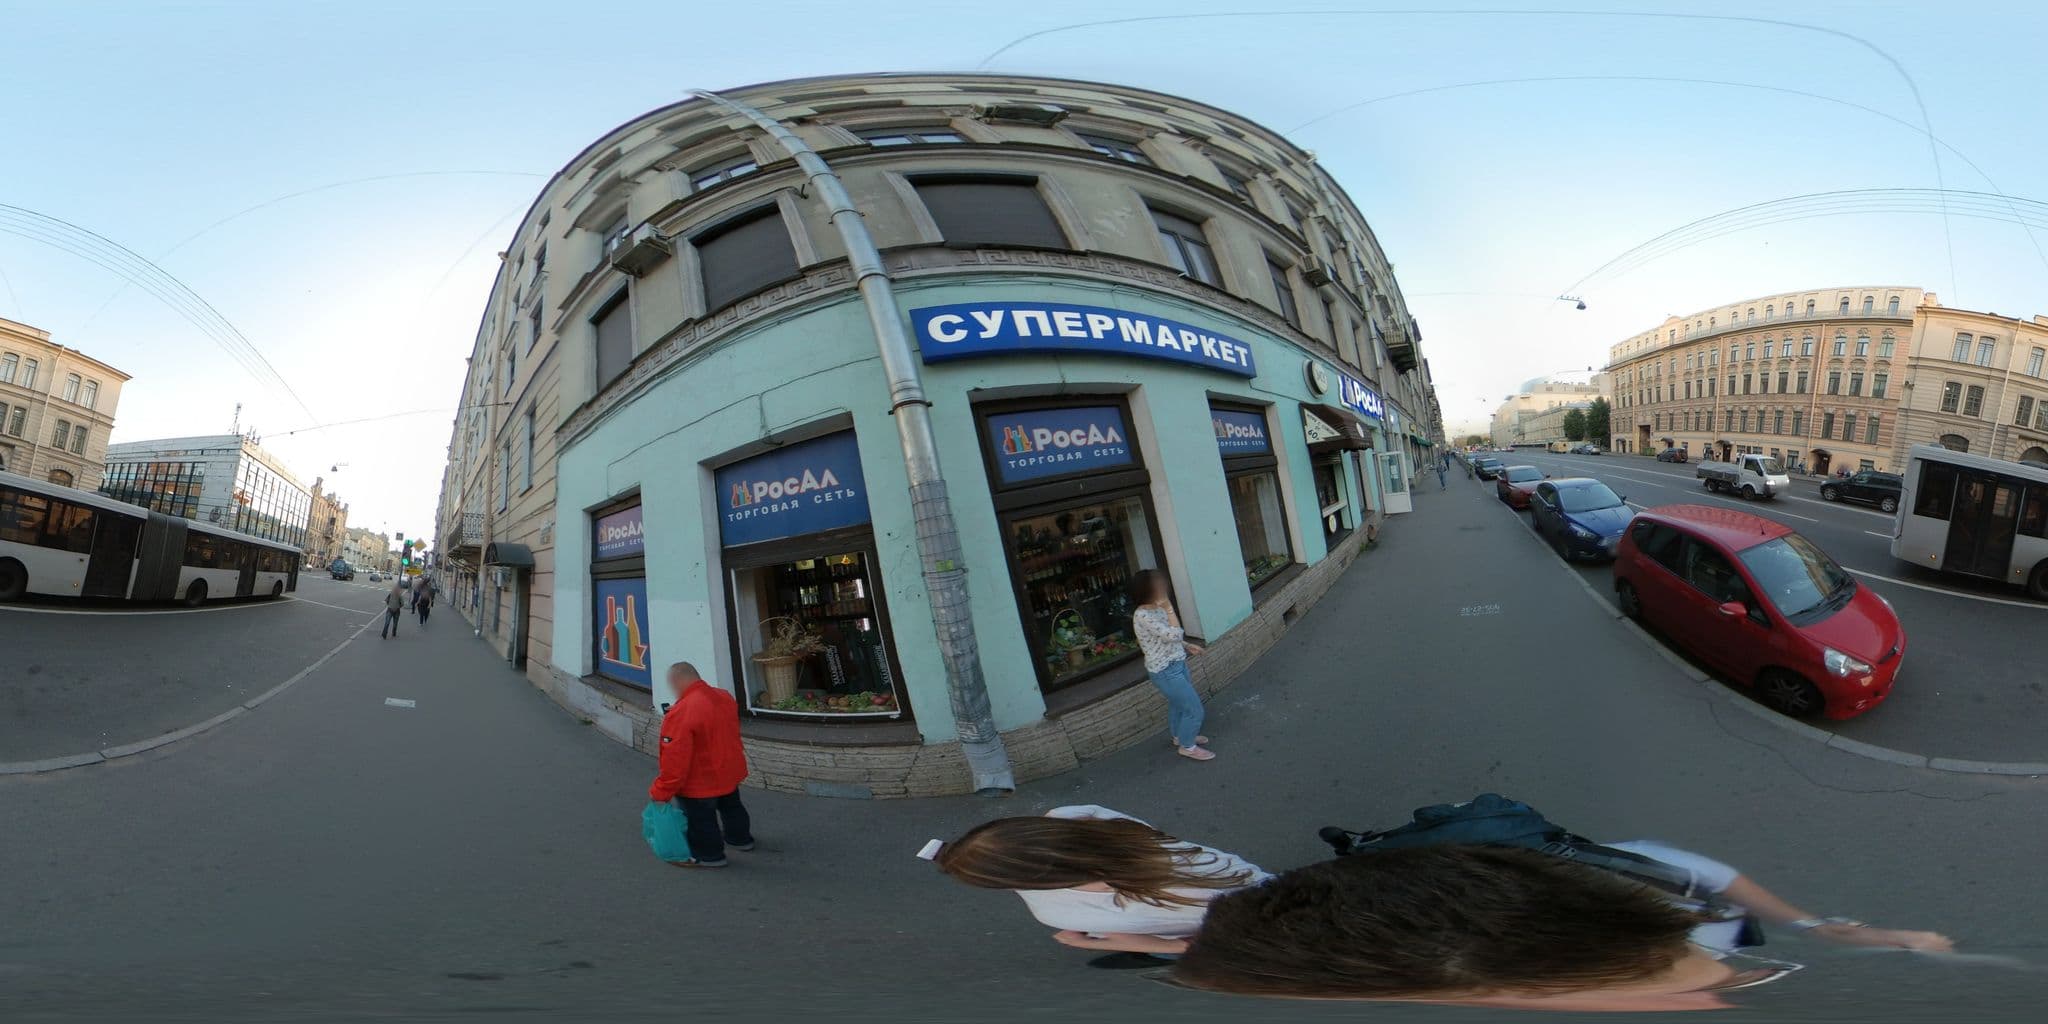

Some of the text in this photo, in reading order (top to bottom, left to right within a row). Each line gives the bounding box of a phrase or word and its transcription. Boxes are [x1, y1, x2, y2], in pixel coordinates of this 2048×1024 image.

[927, 309, 1249, 367] СУПЕРМАРКЕТ
[1008, 447, 1125, 469] ТОРГОВАЯ СЕТЬ
[728, 488, 856, 522] ТОРГОВАЯ СЕТЬ
